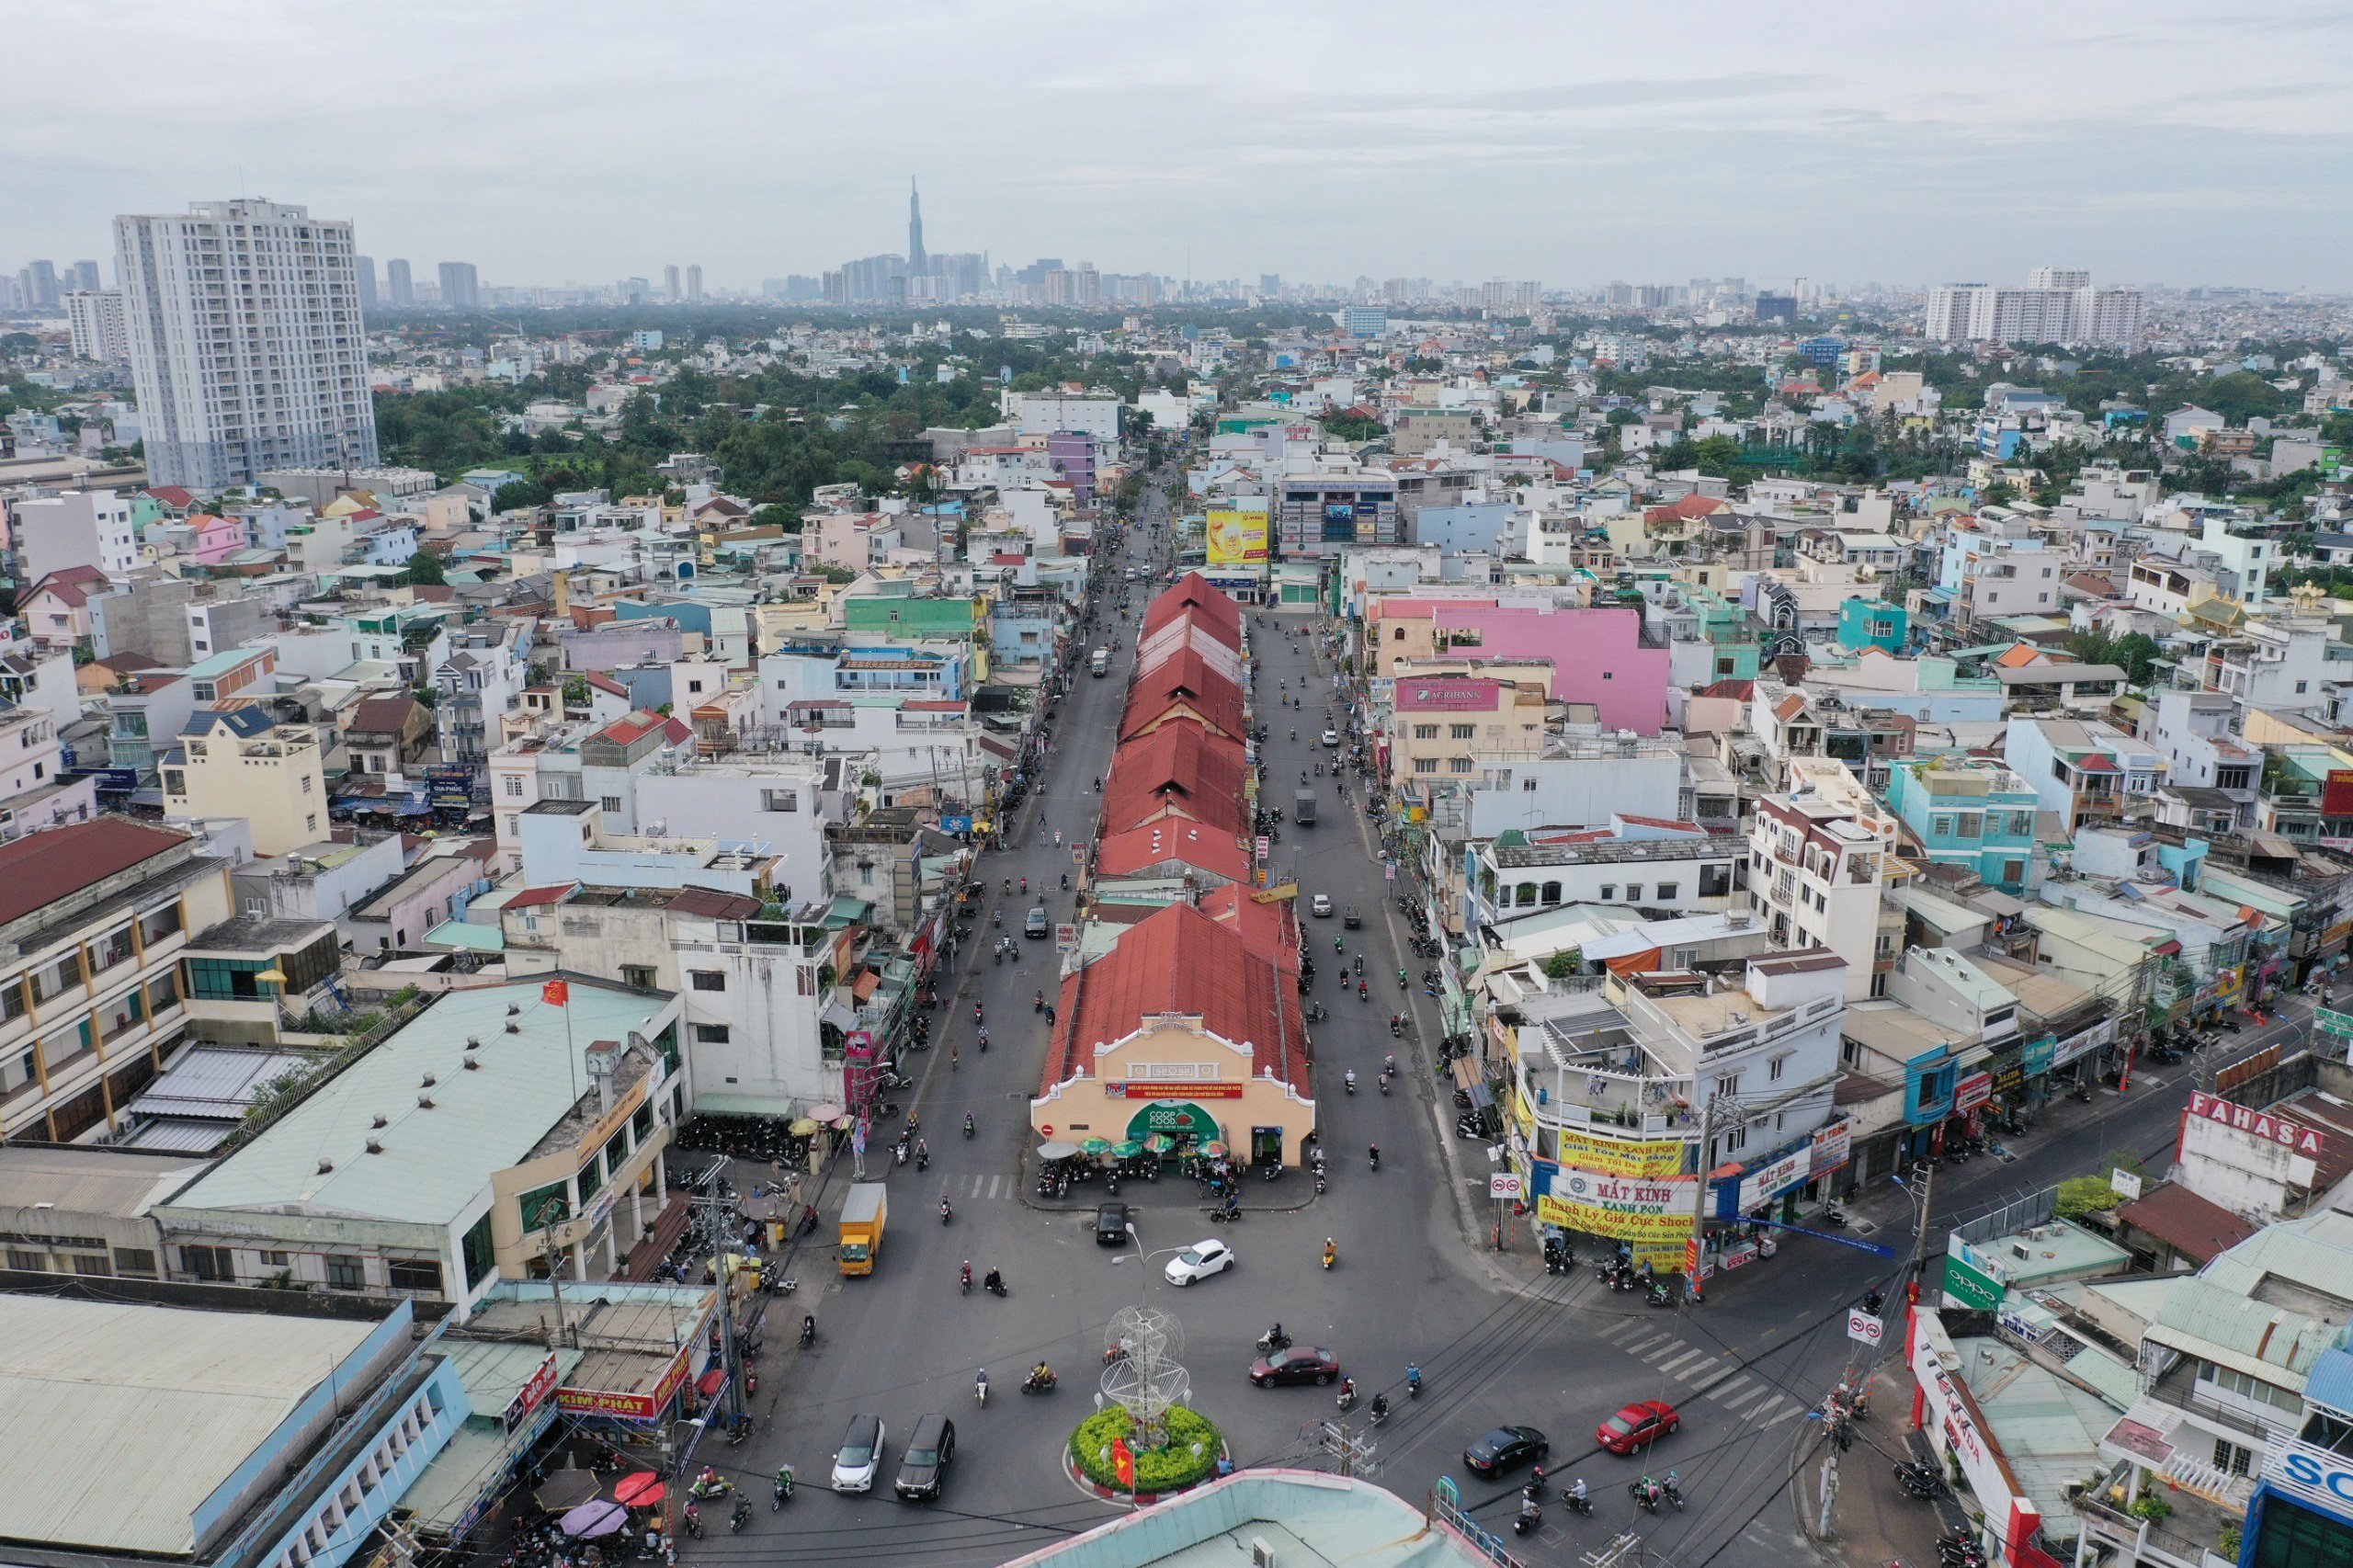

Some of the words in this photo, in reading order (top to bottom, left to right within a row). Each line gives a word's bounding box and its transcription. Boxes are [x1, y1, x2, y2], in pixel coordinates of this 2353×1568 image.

[1431, 691, 1482, 699] AGRIBANK
[2191, 1095, 2318, 1153] FAHASA
[1623, 1143, 1653, 1155] XANH
[1597, 1177, 1630, 1200] MẮT
[1634, 1181, 1672, 1203] KÍNH
[1542, 1198, 1580, 1216] Thanh
[1585, 1208, 1600, 1221] Lý
[1604, 1213, 1625, 1224] Giá
[1631, 1216, 1654, 1228] Cực
[1659, 1217, 1695, 1227] Shock
[1602, 1200, 1636, 1213] XANH
[1640, 1204, 1665, 1214] PON
[2003, 1318, 2024, 1337] XUÂN
[656, 1380, 672, 1402] KIM
[672, 1353, 689, 1380] PHÁT
[558, 1393, 595, 1406] KIM
[598, 1396, 644, 1411] PHÁT
